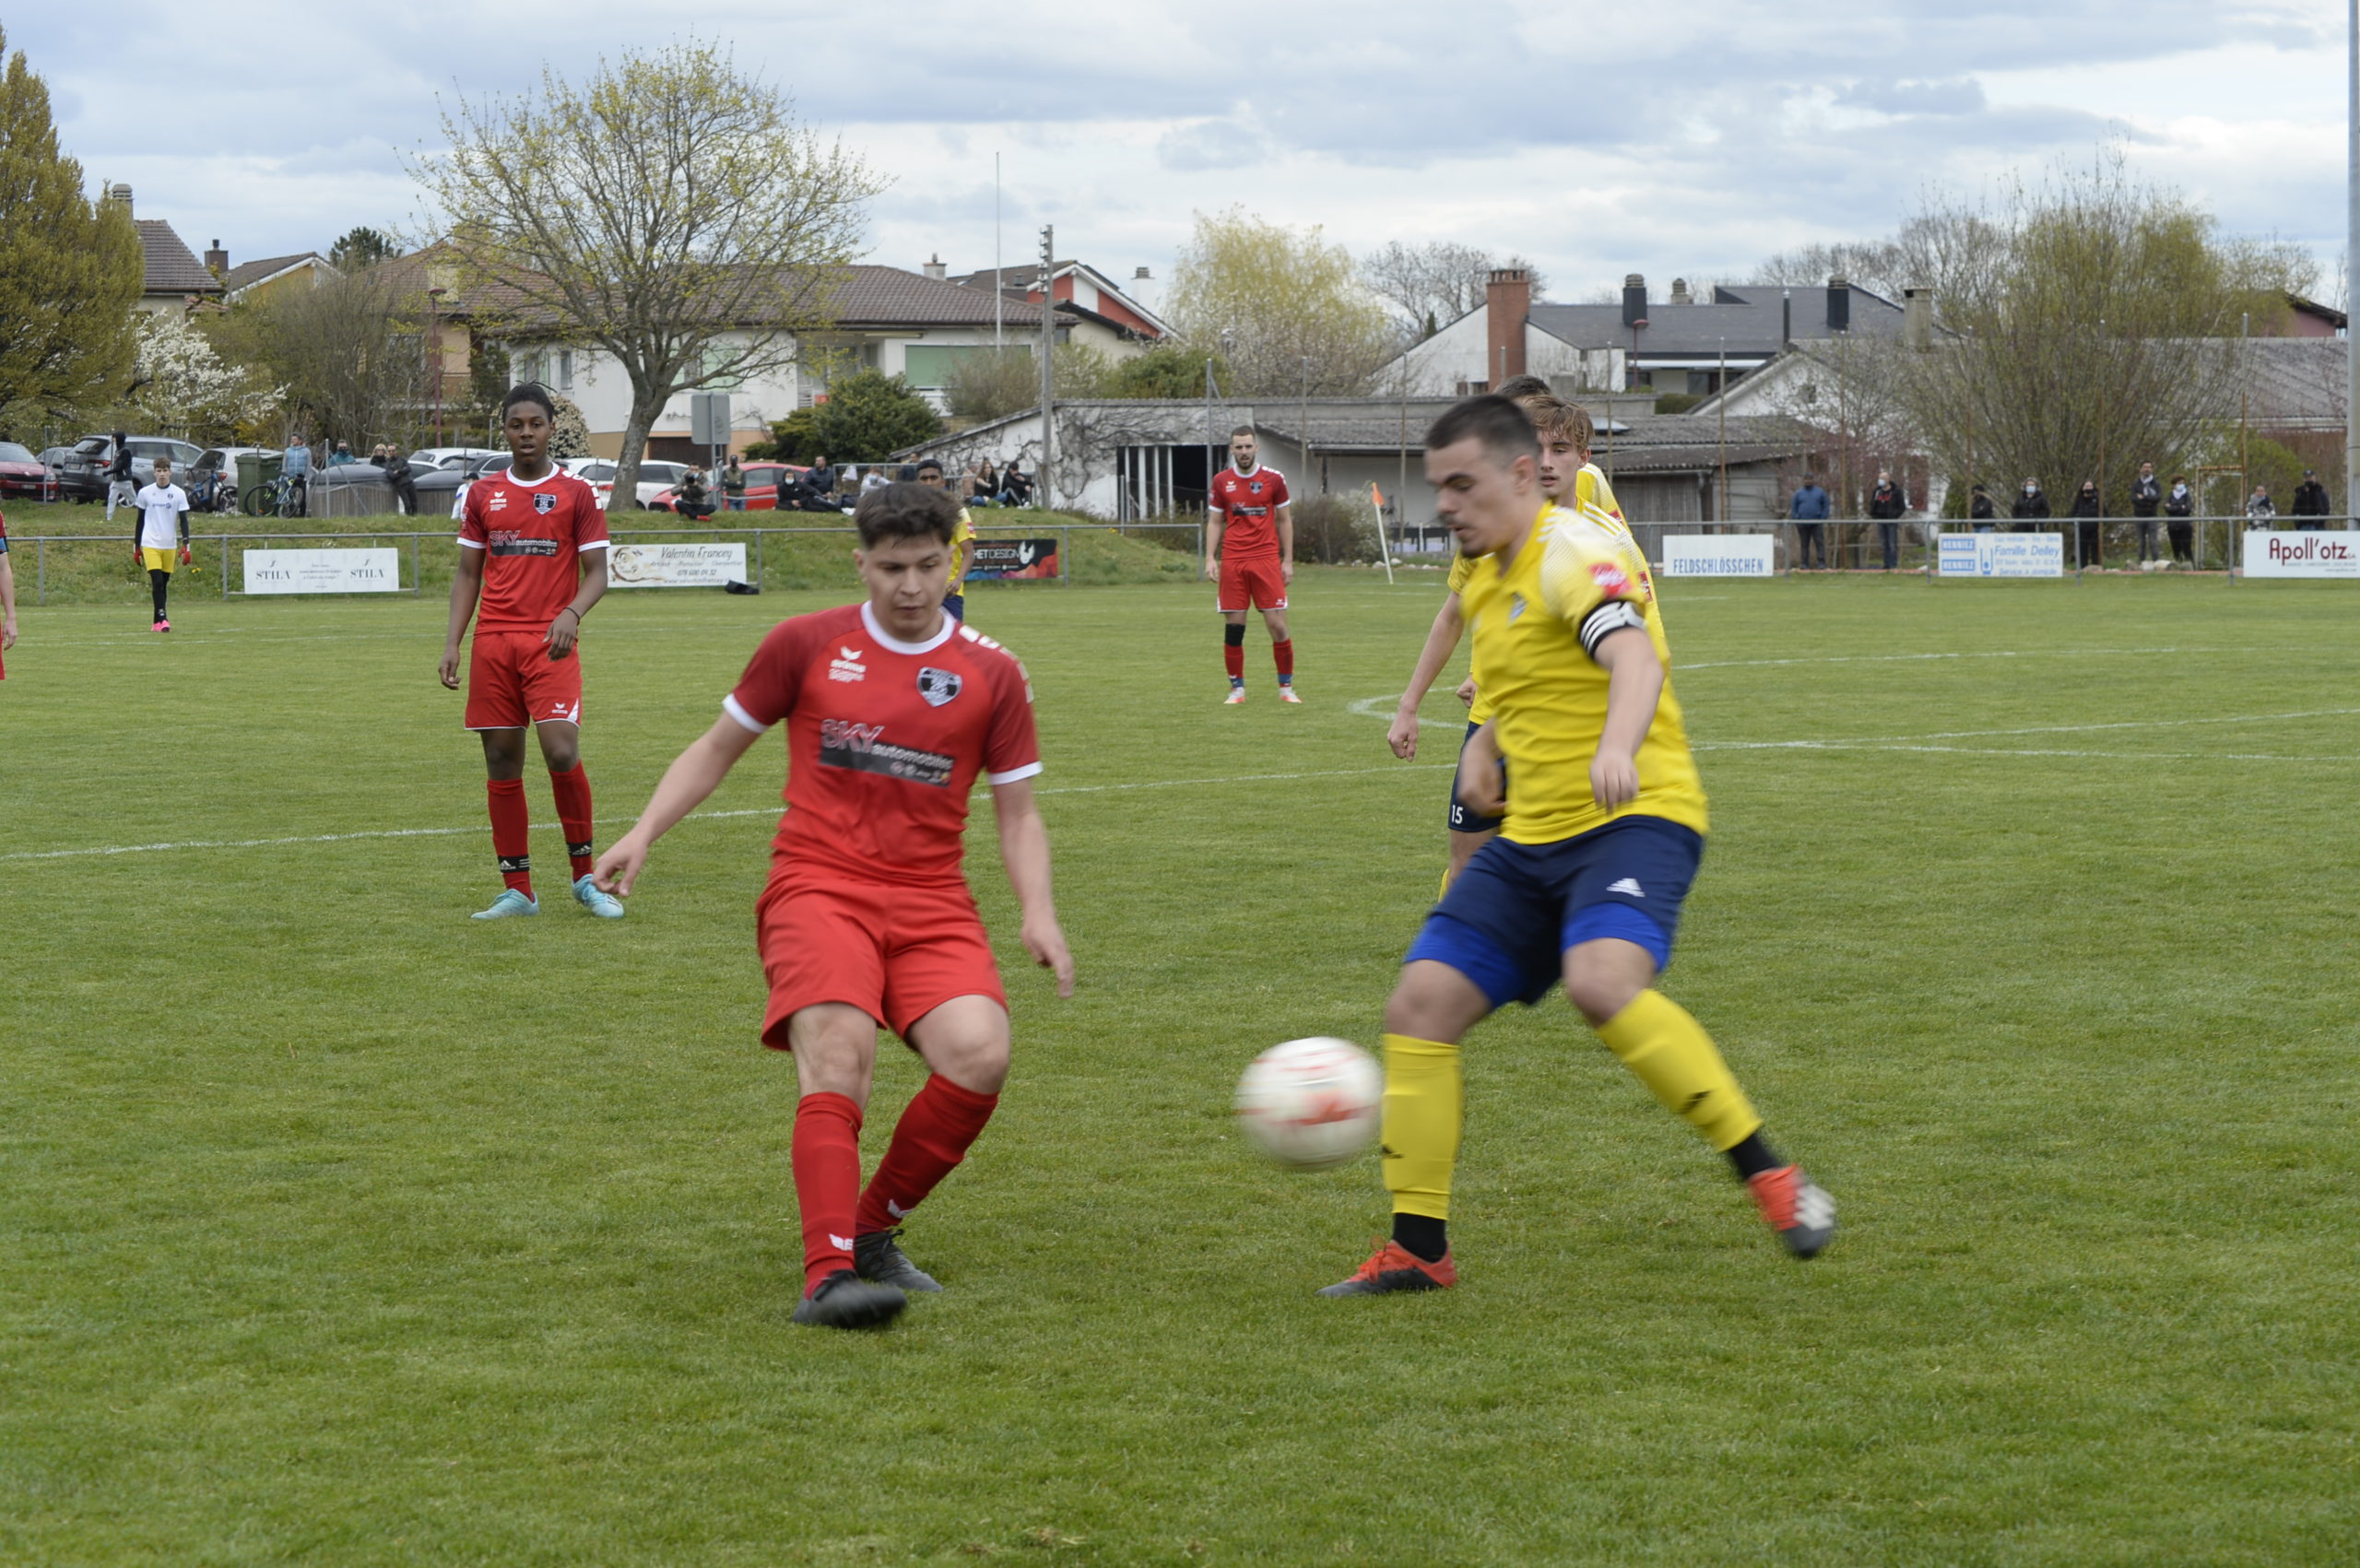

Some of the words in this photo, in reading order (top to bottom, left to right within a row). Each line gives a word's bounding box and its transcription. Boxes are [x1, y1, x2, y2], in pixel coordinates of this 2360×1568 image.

[489, 530, 521, 547] SKY
[661, 547, 695, 559] Valentin
[697, 546, 733, 560] Francey
[1995, 546, 2026, 556] Famille
[2269, 536, 2348, 566] Apoll'otz
[1673, 557, 1764, 573] FELDSCHLÖSSCHEN
[255, 571, 290, 581] STILA
[349, 568, 384, 579] STILA
[820, 718, 885, 753] SKY
[1451, 804, 1463, 824] 15
